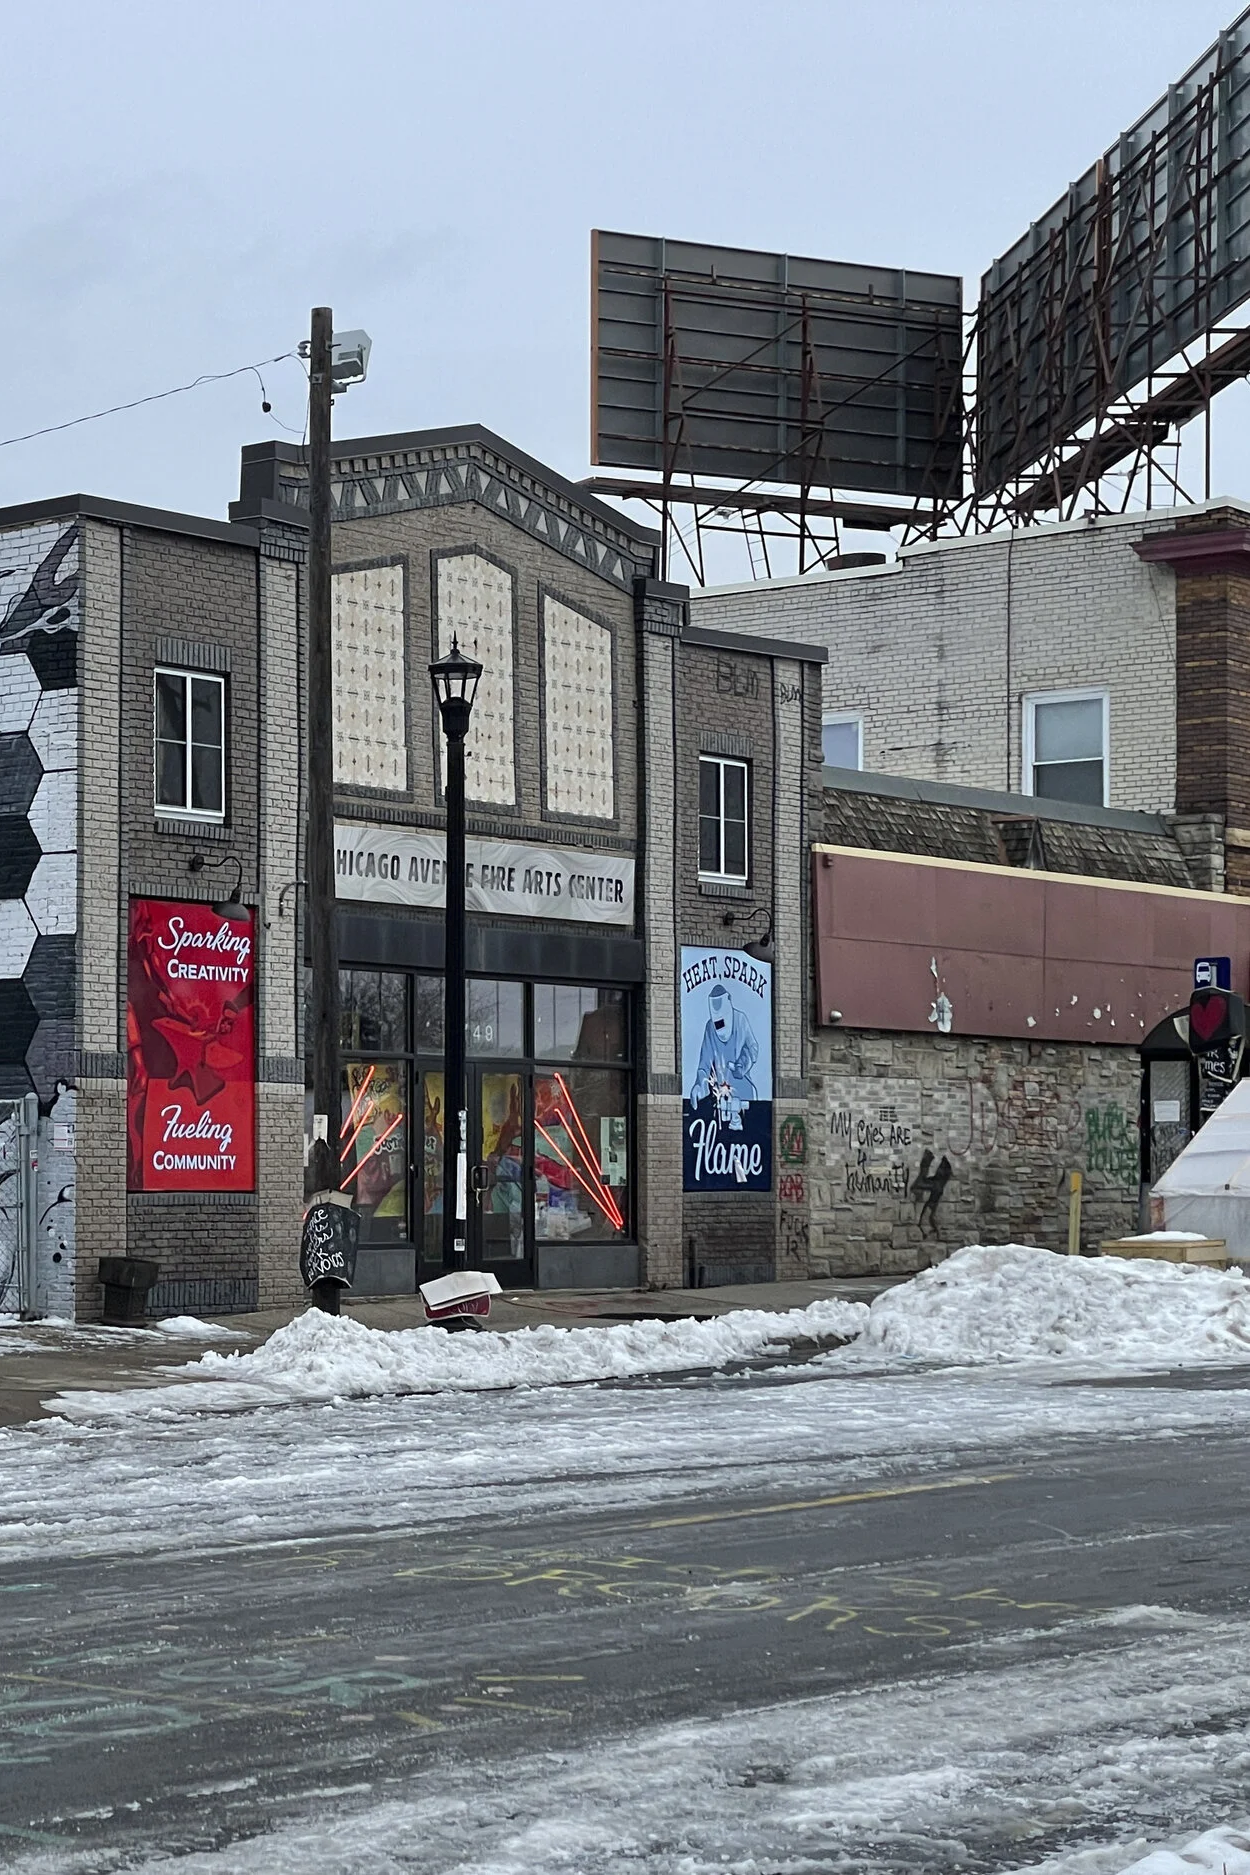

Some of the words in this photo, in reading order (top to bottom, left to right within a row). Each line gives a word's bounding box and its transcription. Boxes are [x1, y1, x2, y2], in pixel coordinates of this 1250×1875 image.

[336, 849, 400, 881] HICAGO
[408, 856, 474, 888] AVEE
[480, 863, 515, 892] FIRE
[522, 868, 561, 896] ARTS
[568, 874, 624, 903] CENTER
[158, 916, 251, 964] Sparking
[167, 959, 249, 983] CREATIVITY
[682, 956, 722, 994] HEAT,
[723, 955, 768, 999] SPARK
[161, 1104, 233, 1152] Fueling
[688, 1118, 763, 1182] Flame
[889, 1126, 912, 1147] ARE
[152, 1150, 237, 1171] COMMUNITY
